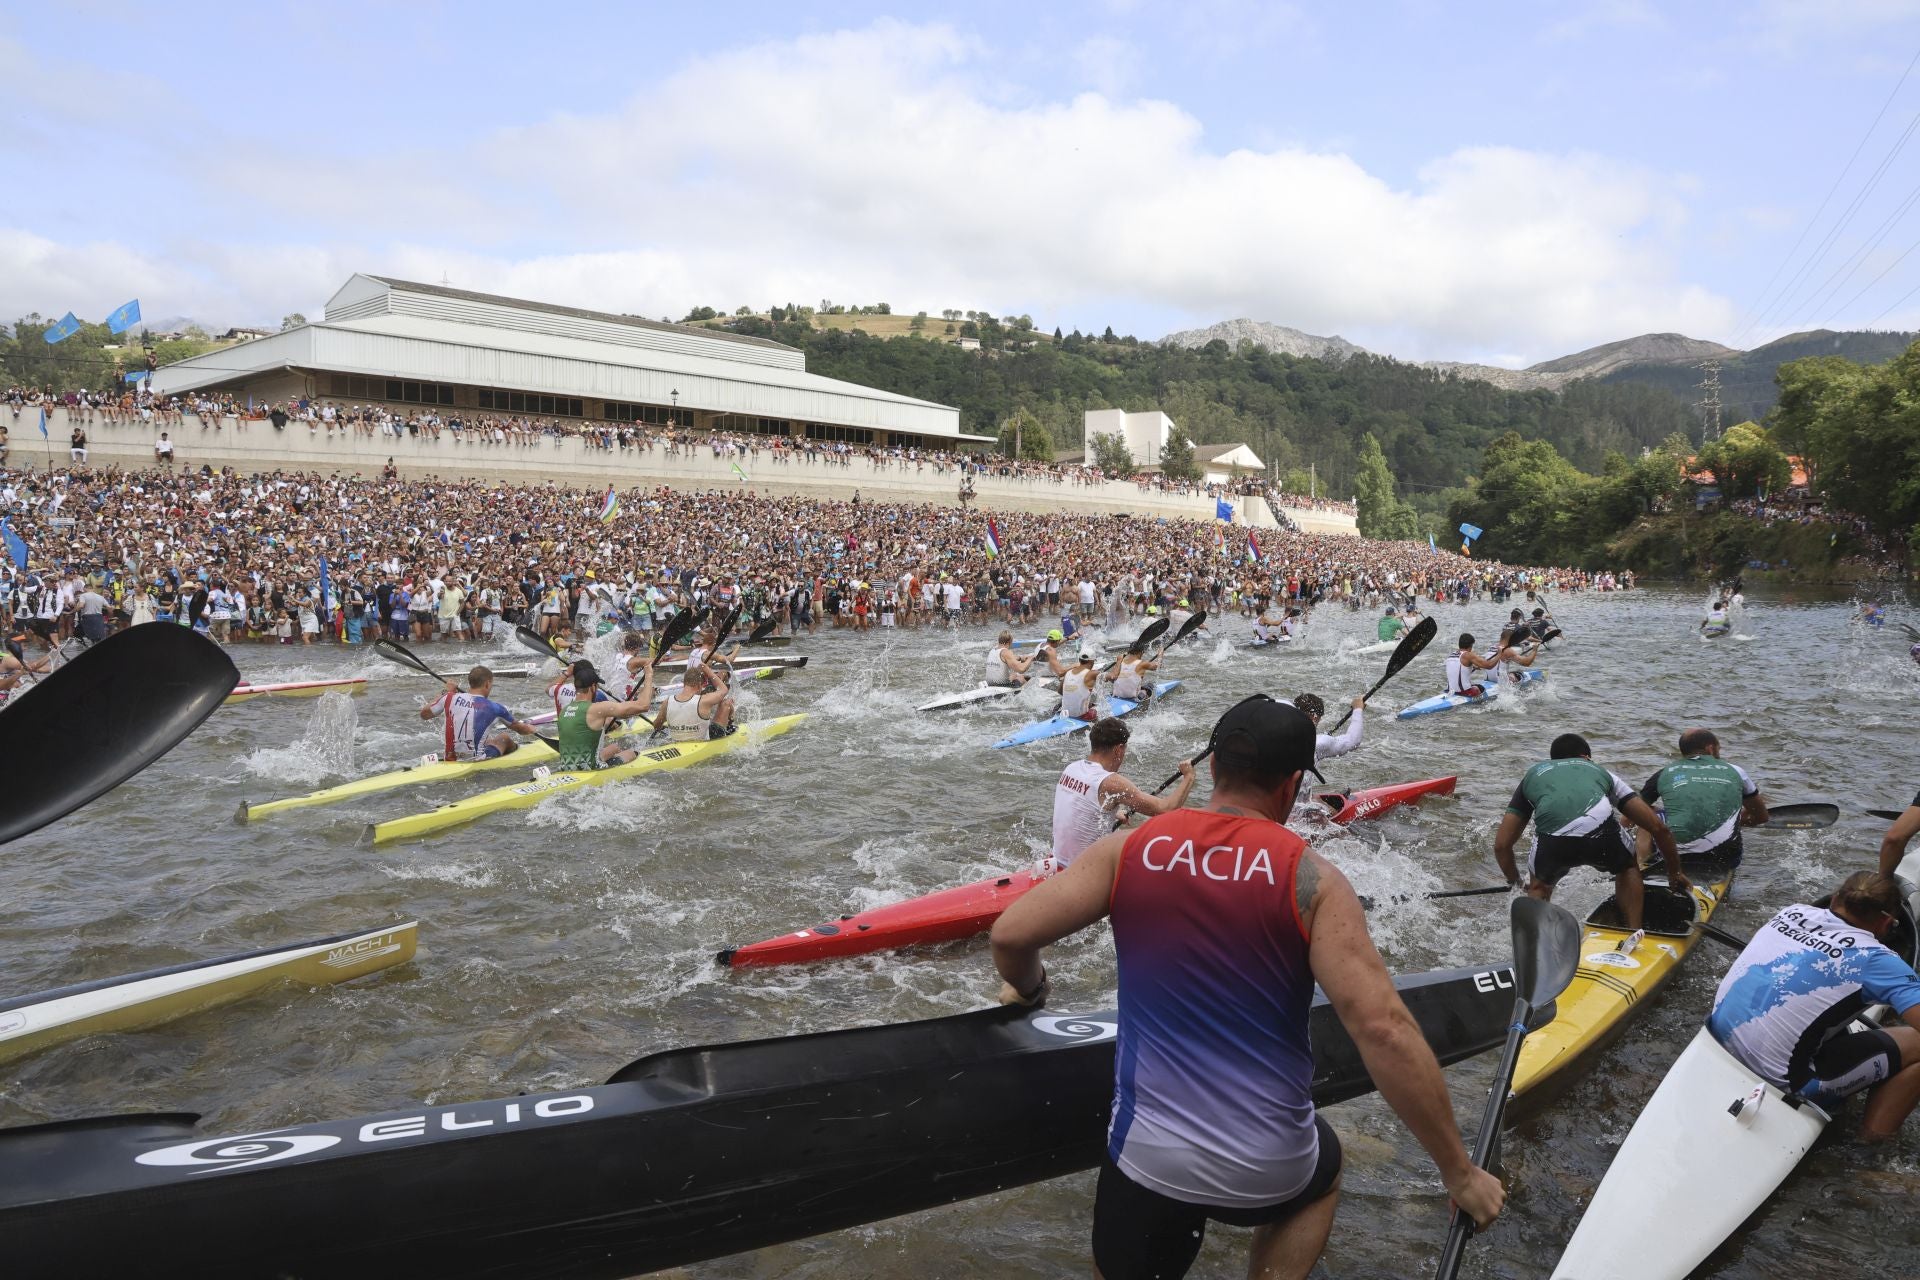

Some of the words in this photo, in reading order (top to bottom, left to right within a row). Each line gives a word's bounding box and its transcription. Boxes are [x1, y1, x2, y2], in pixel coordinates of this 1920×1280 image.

[427, 754, 436, 763] 12
[658, 747, 682, 762] FENN
[538, 767, 548, 775] 11
[1059, 775, 1091, 796] UNGARY
[1044, 860, 1051, 871] 5
[1142, 835, 1275, 886] CACIA
[328, 937, 382, 960] MACH
[358, 1095, 595, 1142] ELIO
